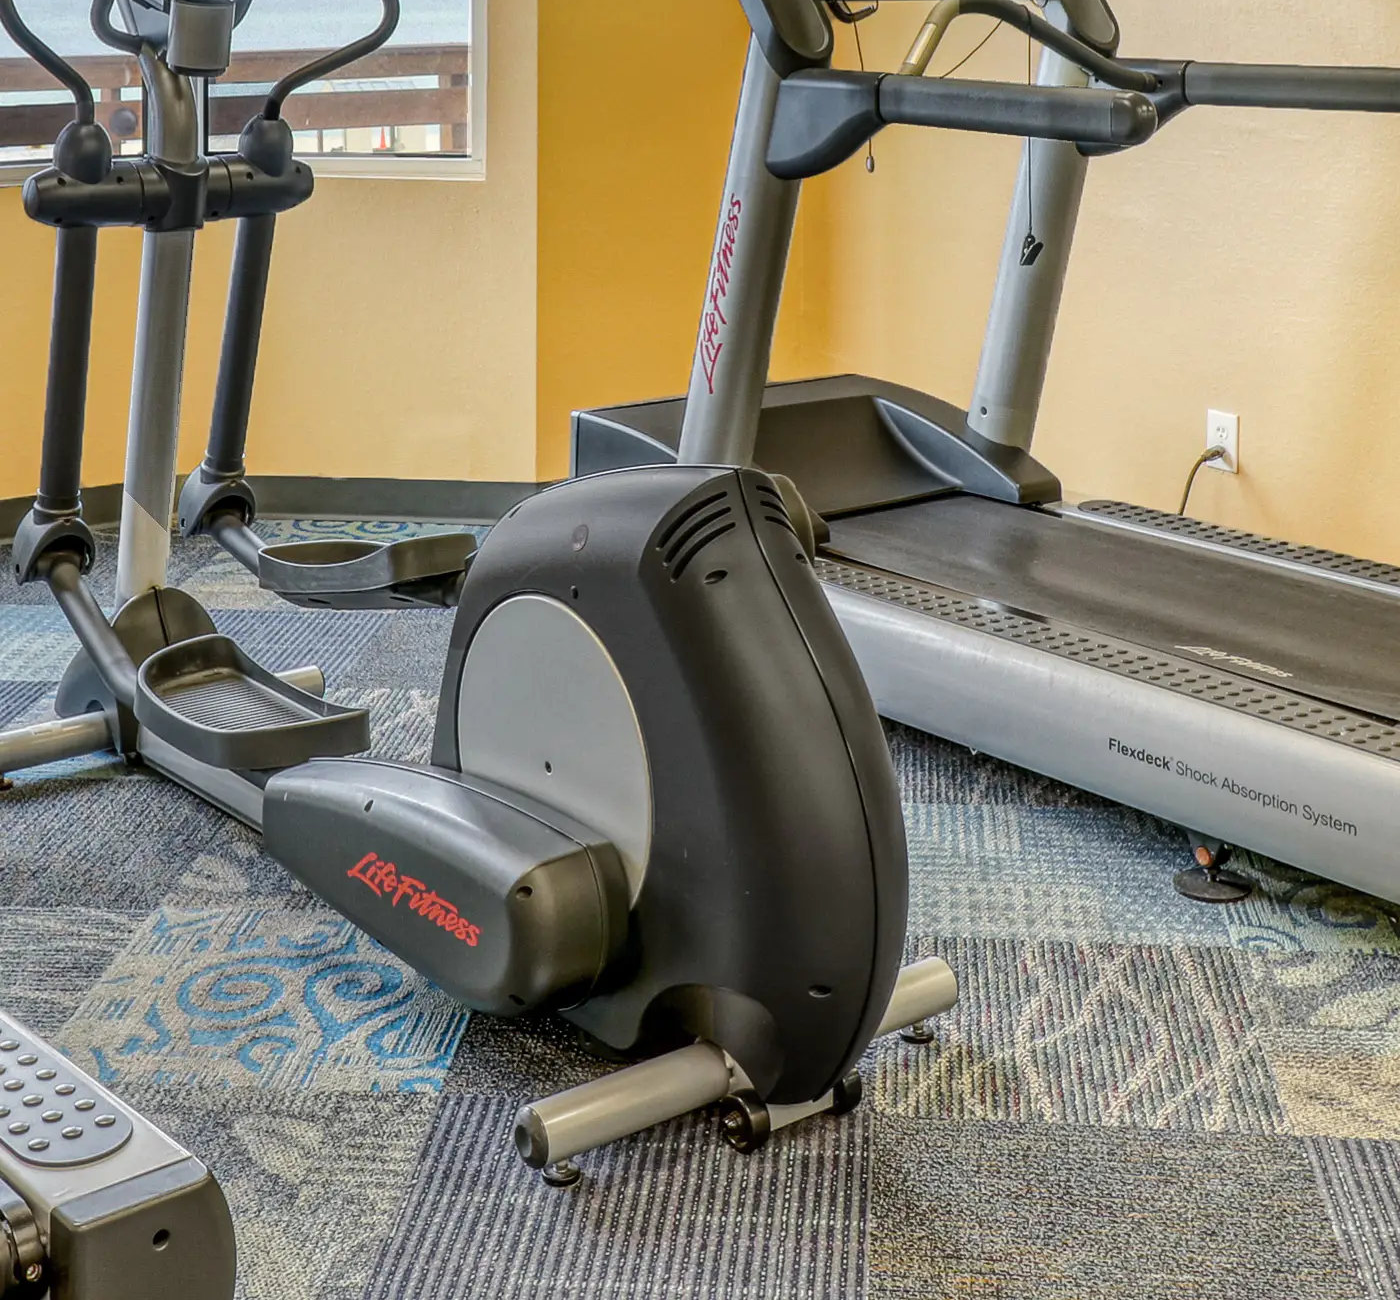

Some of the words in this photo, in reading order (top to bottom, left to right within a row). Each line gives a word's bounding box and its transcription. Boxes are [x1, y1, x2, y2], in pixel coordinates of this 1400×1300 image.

[1176, 760, 1218, 787] Shock
[1220, 777, 1298, 815] Absorption
[1302, 804, 1357, 836] System
